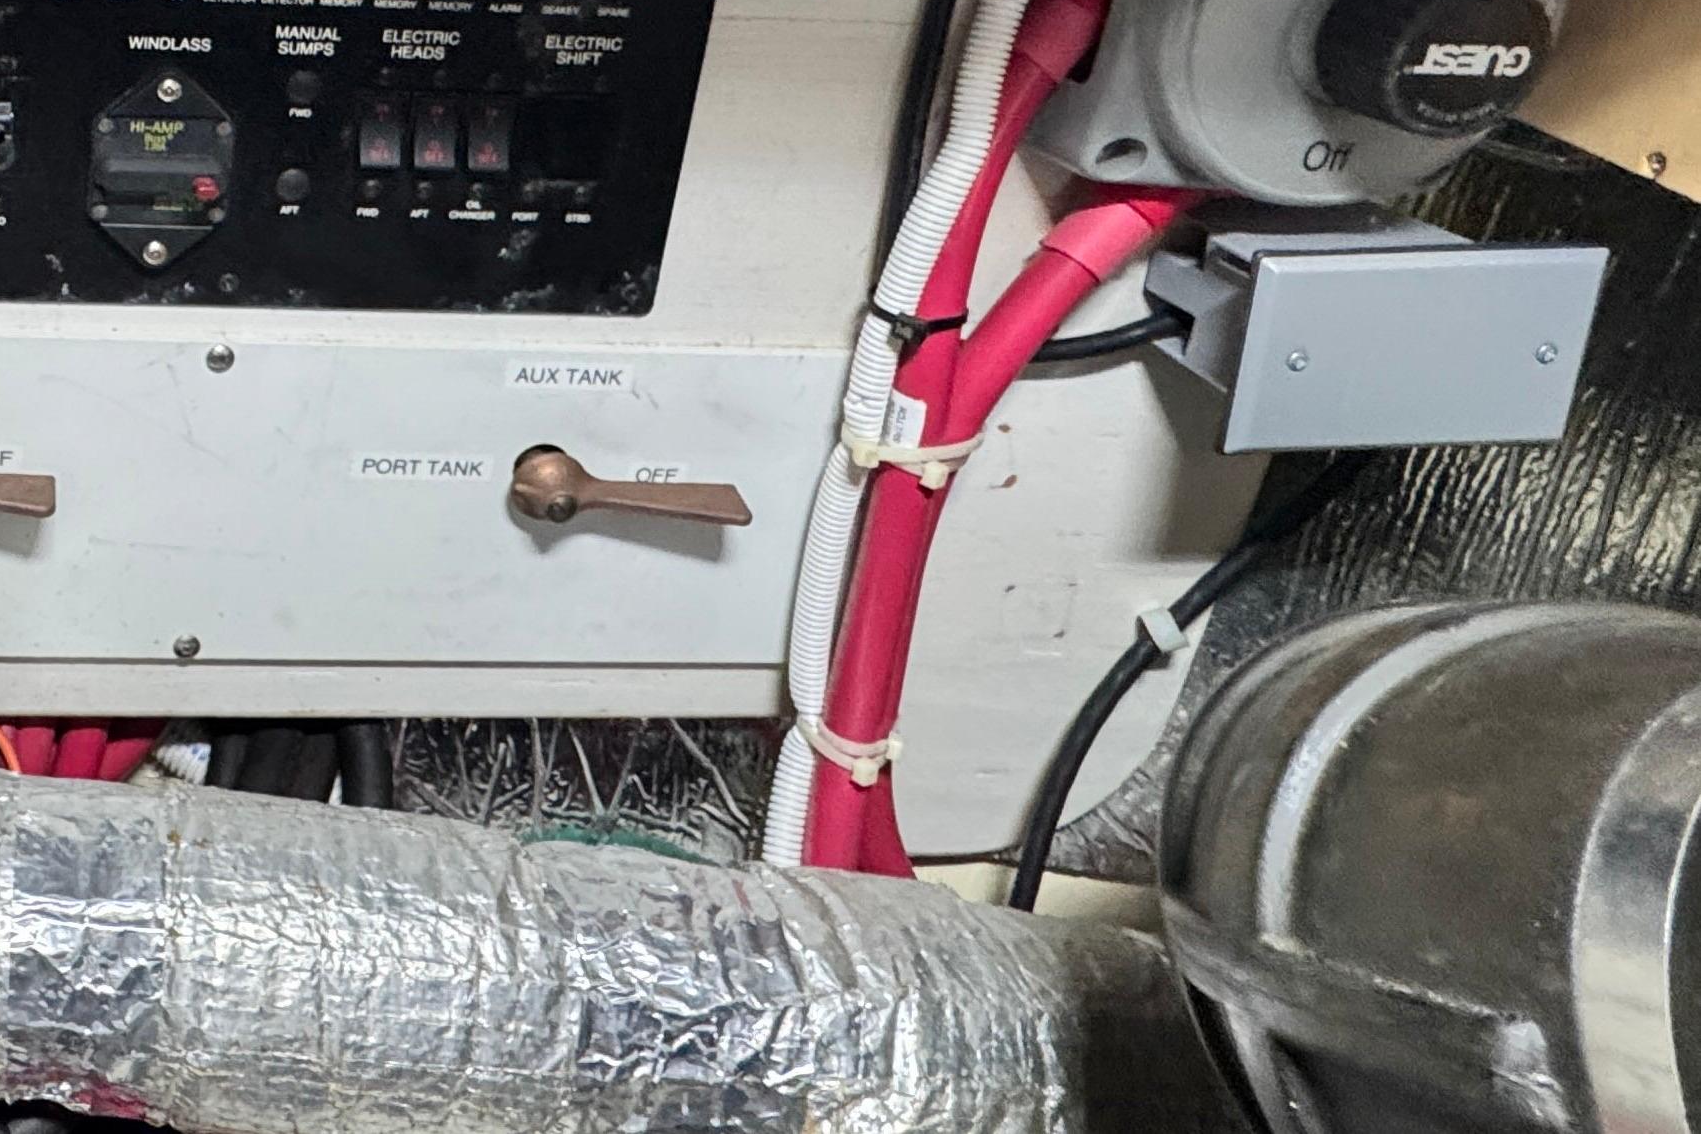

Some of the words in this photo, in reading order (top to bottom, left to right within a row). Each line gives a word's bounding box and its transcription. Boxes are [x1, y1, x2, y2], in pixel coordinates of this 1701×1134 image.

[275, 24, 342, 41] MANUAL
[382, 29, 461, 46] ELECTRIC
[128, 36, 212, 52] WINDLASS
[277, 40, 335, 57] SUMPS
[545, 34, 624, 51] ELECTRIC
[391, 45, 446, 60] HEADS
[555, 51, 602, 65] SHIFT
[1413, 43, 1532, 78] GUEST
[289, 108, 312, 118] FWD
[130, 120, 185, 135] HI-AMP
[279, 204, 300, 215] AFT
[356, 207, 380, 218] FWD
[410, 208, 430, 219] AFT
[512, 212, 539, 222] PORT
[514, 367, 561, 384] AUX
[567, 369, 623, 386] TANK
[361, 458, 422, 475] PORT
[428, 460, 485, 477] TANK
[636, 467, 680, 483] OFF
